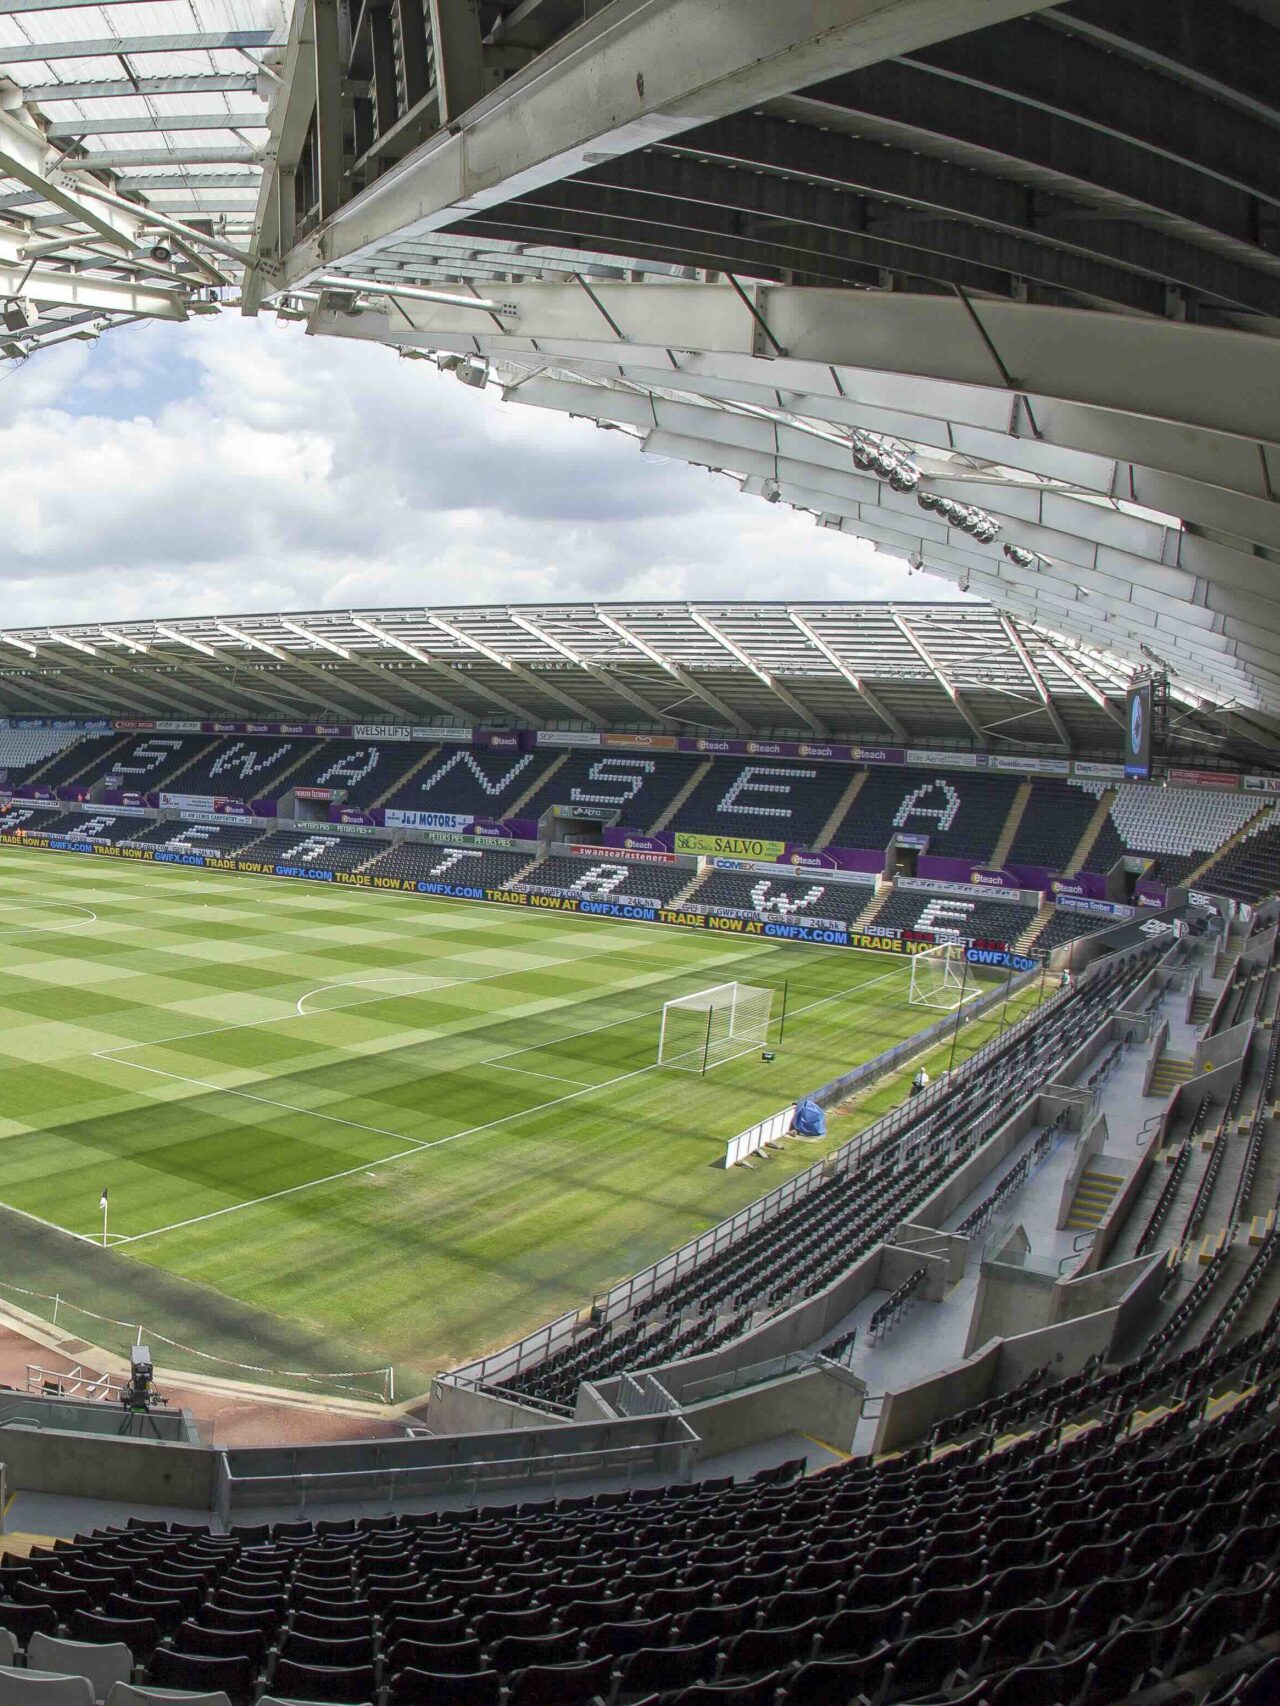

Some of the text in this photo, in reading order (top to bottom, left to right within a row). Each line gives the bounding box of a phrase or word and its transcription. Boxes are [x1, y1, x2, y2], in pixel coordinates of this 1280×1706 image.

[356, 726, 386, 737] WELSH
[388, 726, 410, 738] LIFTS
[493, 736, 517, 746] eteach
[699, 740, 886, 760] eteach eteach eteach eteach
[112, 739, 960, 831] SWANSEA
[401, 812, 416, 825] J&J
[420, 813, 457, 828] MOTORS
[301, 822, 367, 834] PETERS PIES PETERS PIES
[476, 826, 500, 836] eteach
[428, 832, 512, 848] PETERS PIES PETERS PIES
[628, 839, 653, 850] eteach
[714, 838, 764, 856] SALVO
[716, 860, 756, 872] COMEX
[794, 854, 822, 866] eteach
[974, 873, 1003, 886] eteach
[22, 837, 39, 847] NOW
[40, 839, 50, 848] AT
[50, 840, 92, 853] GWFX.COM
[94, 846, 121, 857] TRADE
[122, 849, 142, 859] NOW
[143, 850, 154, 860] AT
[154, 851, 204, 866] GWFX.COM
[205, 858, 236, 870] TRADE
[238, 862, 261, 873] NOW
[262, 864, 274, 874] AT
[276, 865, 332, 881] GWFX.COM
[334, 872, 371, 886] TRADE
[374, 877, 401, 890] NOW
[402, 880, 417, 891] AT
[417, 881, 483, 900] GWFX.COM
[485, 889, 527, 905] TRADE
[530, 895, 560, 909] NOW
[561, 899, 579, 910] AT
[580, 901, 655, 921] GWFX.COM
[658, 910, 705, 928] TRADE
[708, 916, 743, 932] NOW
[746, 921, 764, 934] AT
[764, 924, 848, 945] GWFX.COM
[850, 934, 902, 952] TRADE
[544, 886, 582, 900] GWFX.COM
[1055, 882, 1083, 895] eteach
[1089, 901, 1111, 913] Timber
[716, 908, 761, 920] GWFX.COM
[864, 926, 903, 939] 12BET
[935, 934, 976, 948] 12BET
